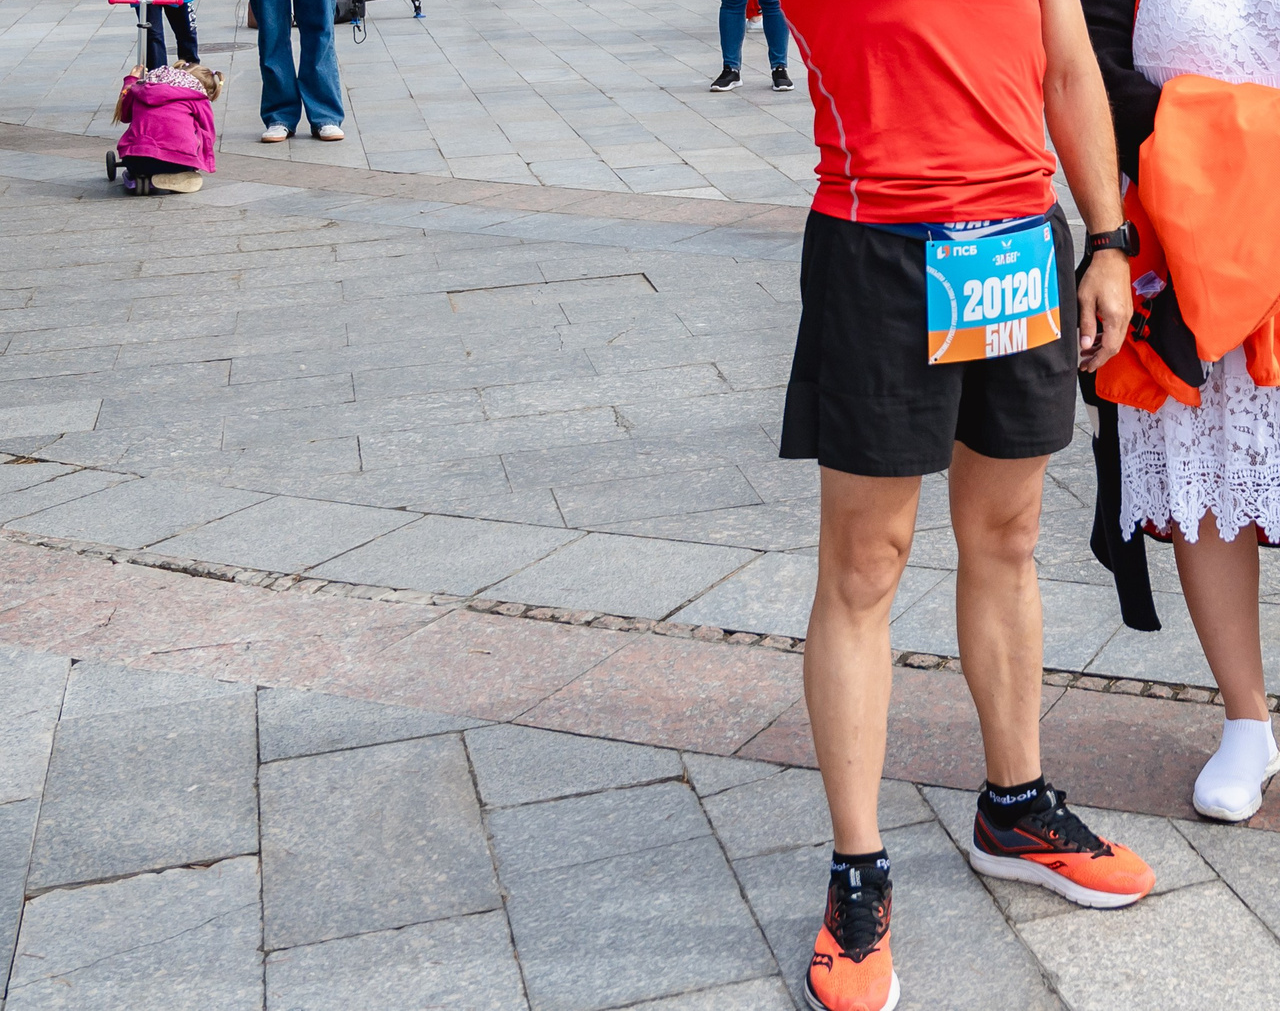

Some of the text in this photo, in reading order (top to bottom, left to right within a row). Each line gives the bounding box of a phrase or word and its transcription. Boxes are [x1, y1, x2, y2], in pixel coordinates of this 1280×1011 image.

[953, 245, 978, 257] ПСБ
[963, 267, 1042, 322] 20120
[985, 317, 1028, 358] 5KM
[989, 788, 1037, 805] Reebok
